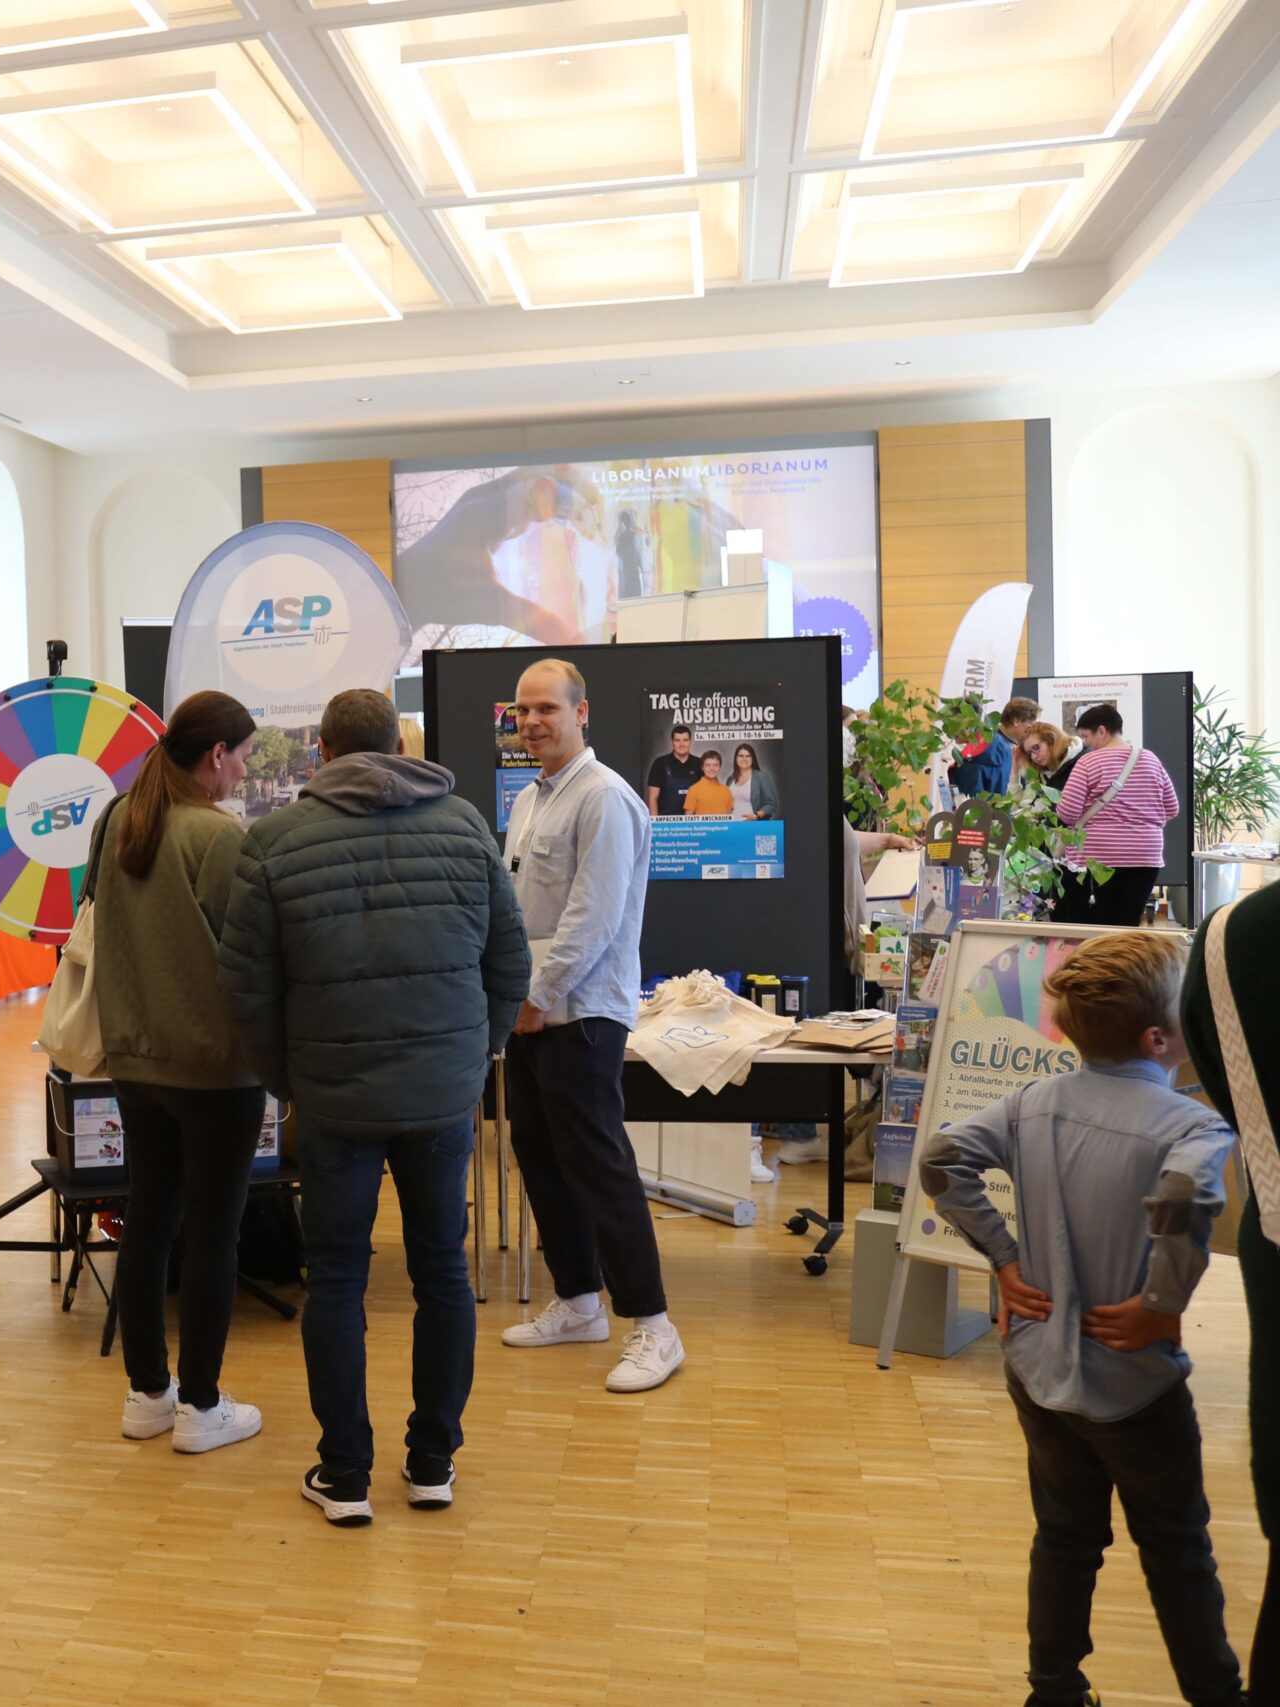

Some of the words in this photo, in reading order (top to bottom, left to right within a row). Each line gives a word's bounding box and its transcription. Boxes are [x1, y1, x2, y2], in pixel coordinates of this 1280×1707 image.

[592, 466, 709, 484] LIBORIANUM
[708, 459, 828, 477] LIBORIANUM
[242, 595, 331, 636] ASP
[649, 694, 679, 709] TAG
[682, 693, 702, 708] der
[705, 692, 748, 708] offenen
[673, 706, 775, 724] AUSBILDUNG
[31, 797, 91, 836] ASP
[959, 1073, 1003, 1086] Abfallkarte
[1006, 1079, 1013, 1087] in
[956, 1089, 969, 1097] am
[883, 1133, 911, 1142] Aufwind
